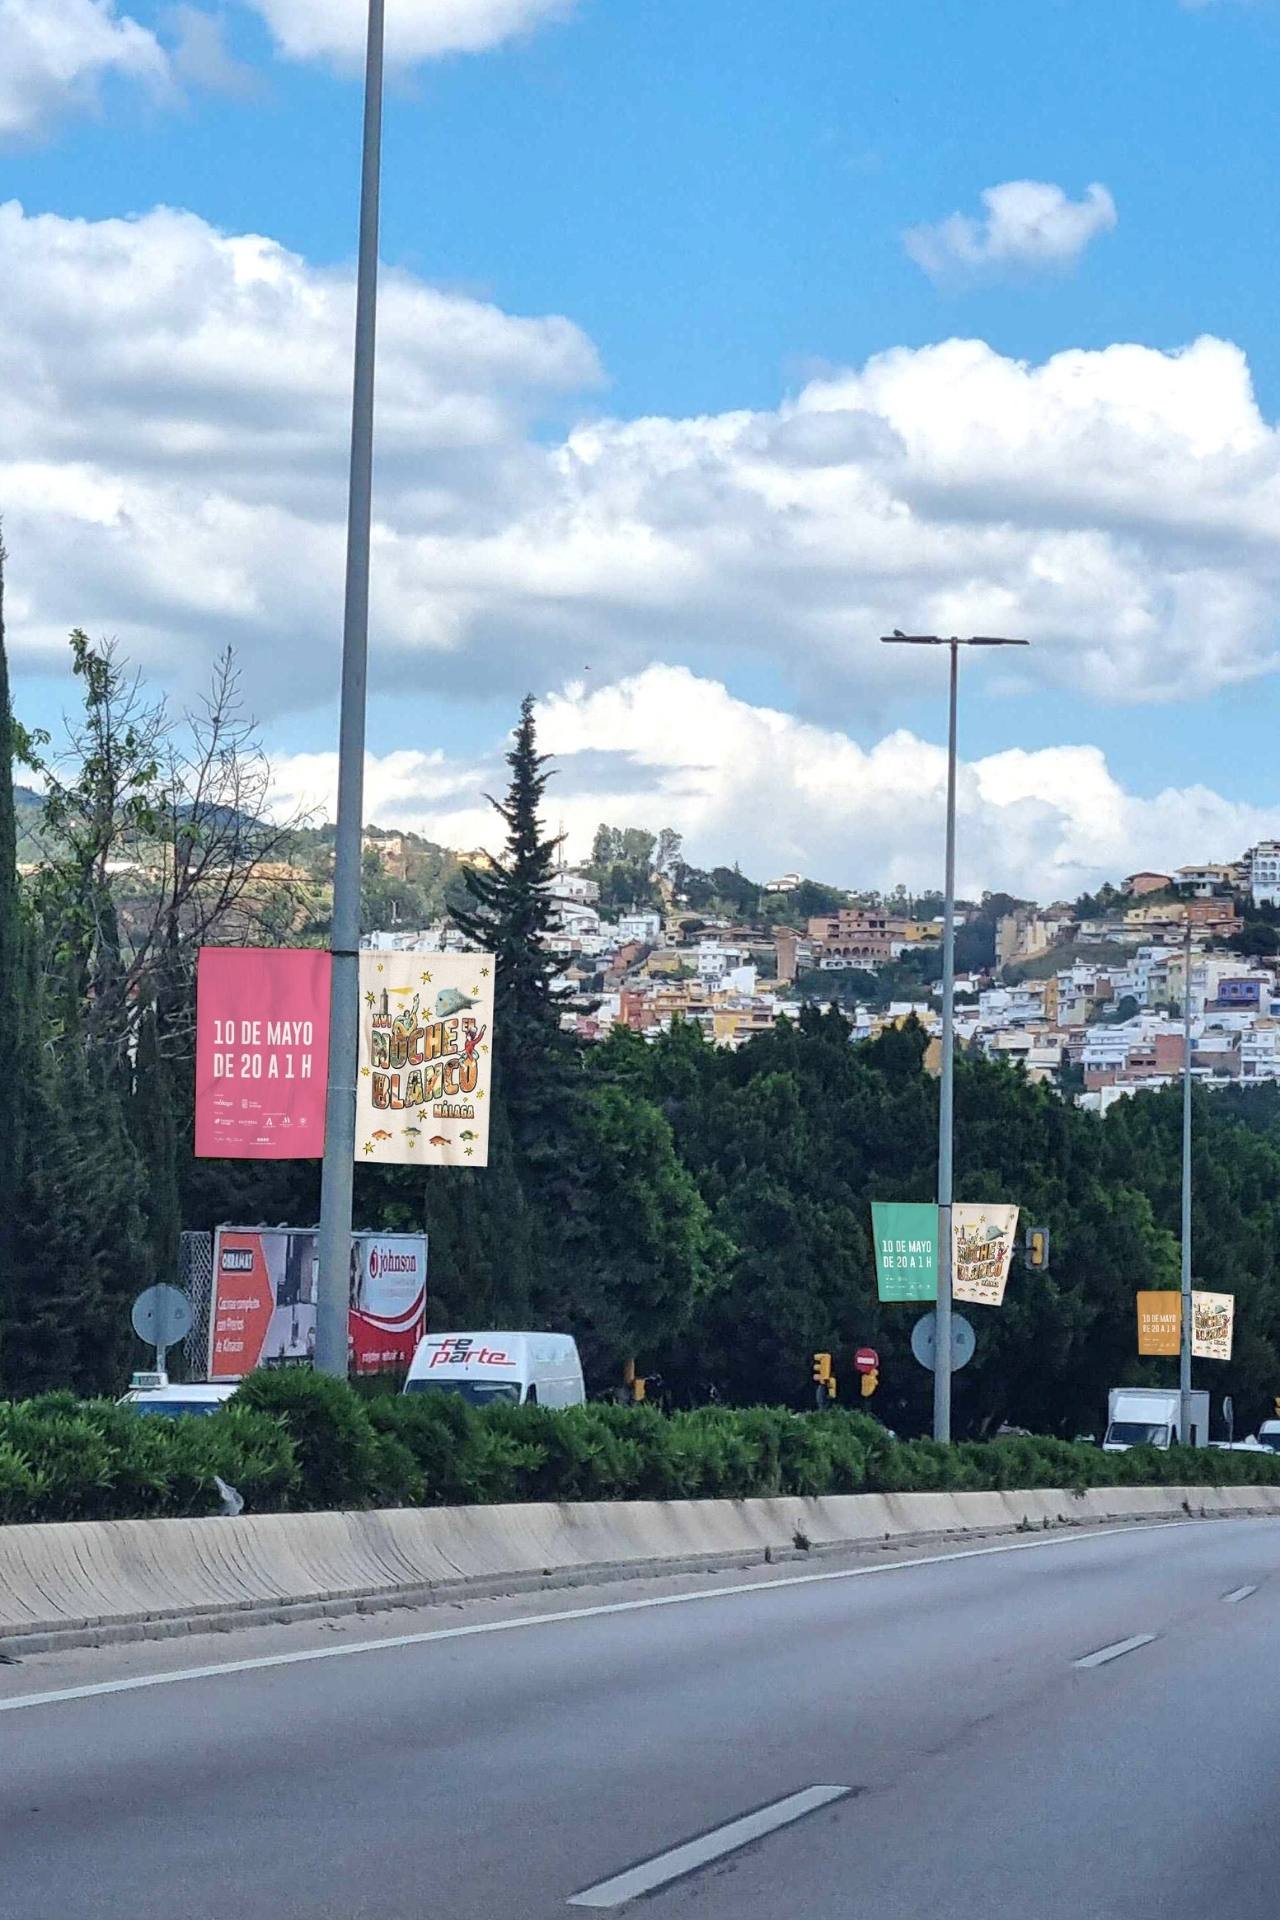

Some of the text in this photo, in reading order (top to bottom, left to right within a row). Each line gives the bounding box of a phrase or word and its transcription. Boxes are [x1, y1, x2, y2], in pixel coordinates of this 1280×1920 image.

[213, 1020, 313, 1046] 10 DE MAYO
[371, 1018, 459, 1069] NOCHE
[213, 1053, 313, 1079] DE 20 A 1 H
[371, 1056, 479, 1110] BLANCO
[433, 1100, 475, 1119] MÁLAGA
[882, 1240, 932, 1253] 10 DE MAYO
[379, 1250, 417, 1279] johnson
[883, 1255, 932, 1268] DE 20 A 1 H
[1143, 1314, 1177, 1323] 10 DE MAYO
[428, 1348, 517, 1369] parte
